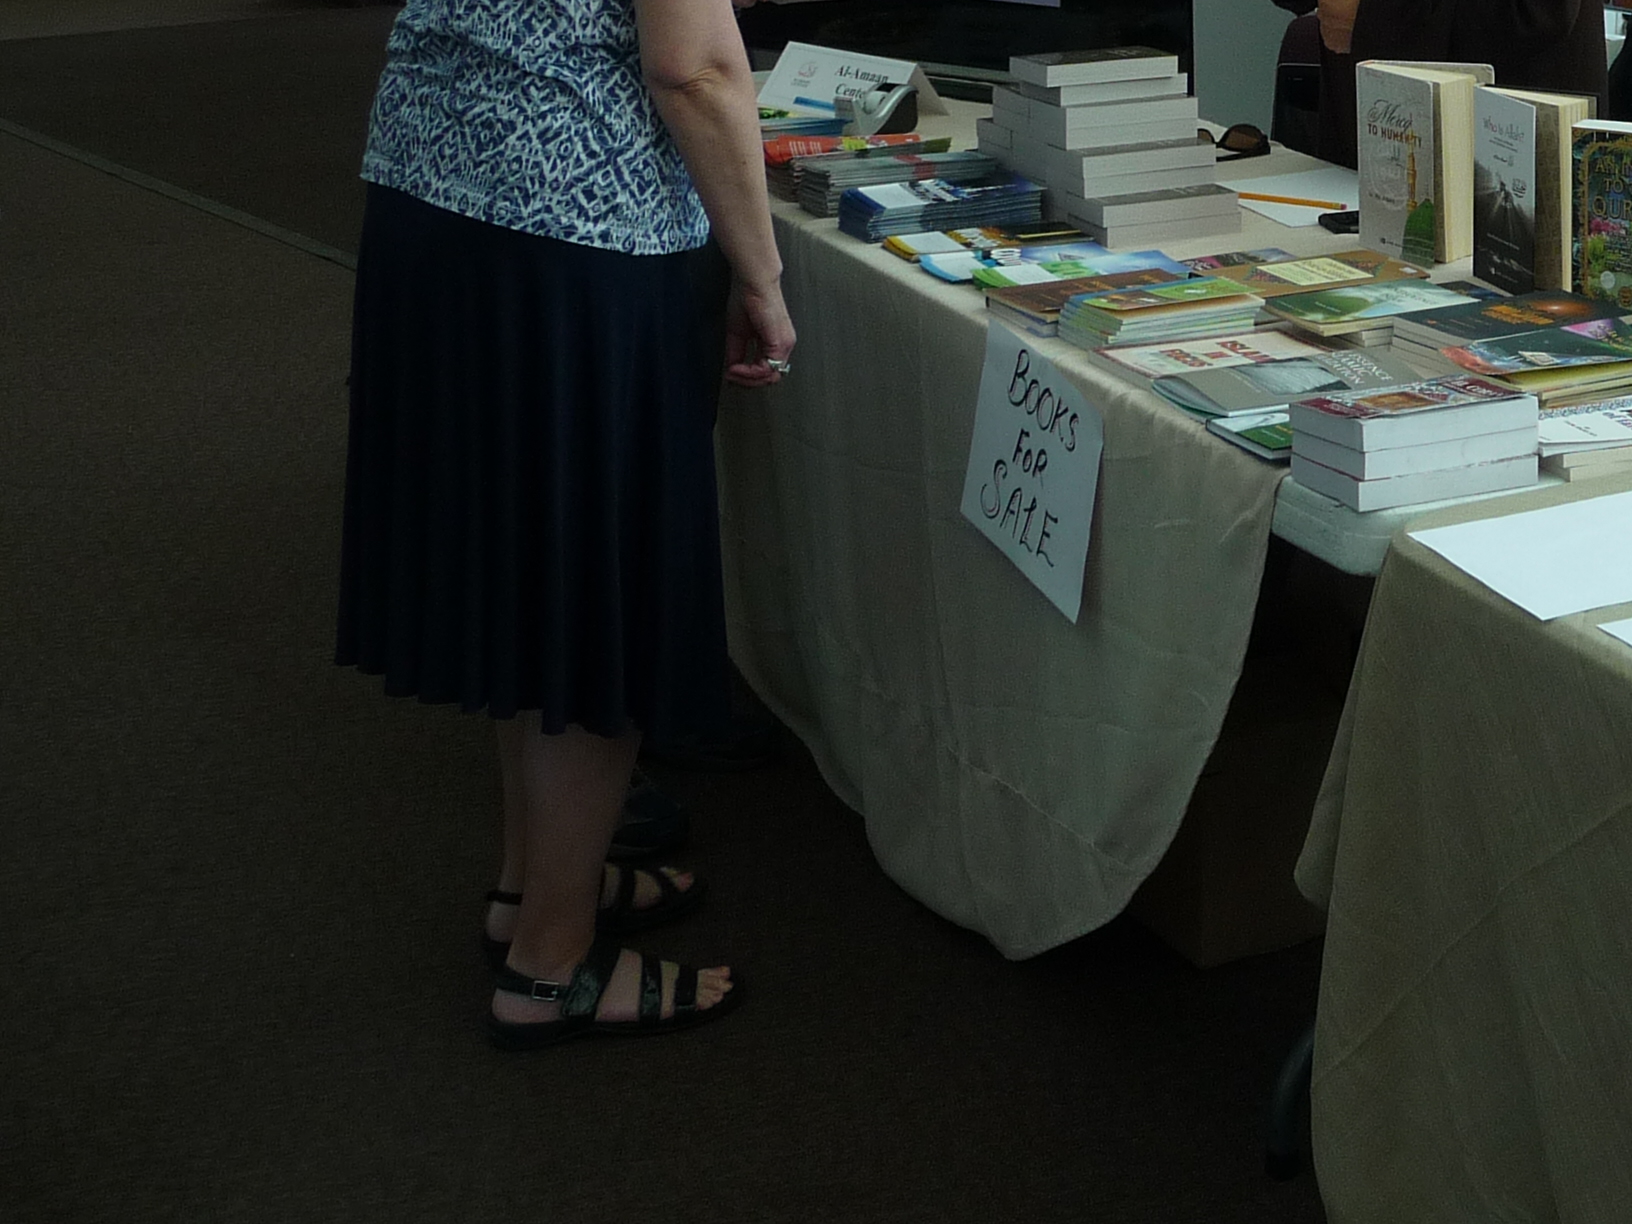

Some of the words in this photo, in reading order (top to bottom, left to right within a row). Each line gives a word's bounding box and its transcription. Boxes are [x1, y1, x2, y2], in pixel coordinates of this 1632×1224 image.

[835, 65, 889, 84] Al-Amaan
[1368, 123, 1378, 135] TO
[1380, 127, 1422, 148] HUMANITY
[1595, 156, 1616, 174] AN
[1603, 178, 1624, 194] TO
[1008, 349, 1079, 453] BOOKS
[1012, 428, 1049, 489] FOR
[980, 459, 1058, 568] SALE
